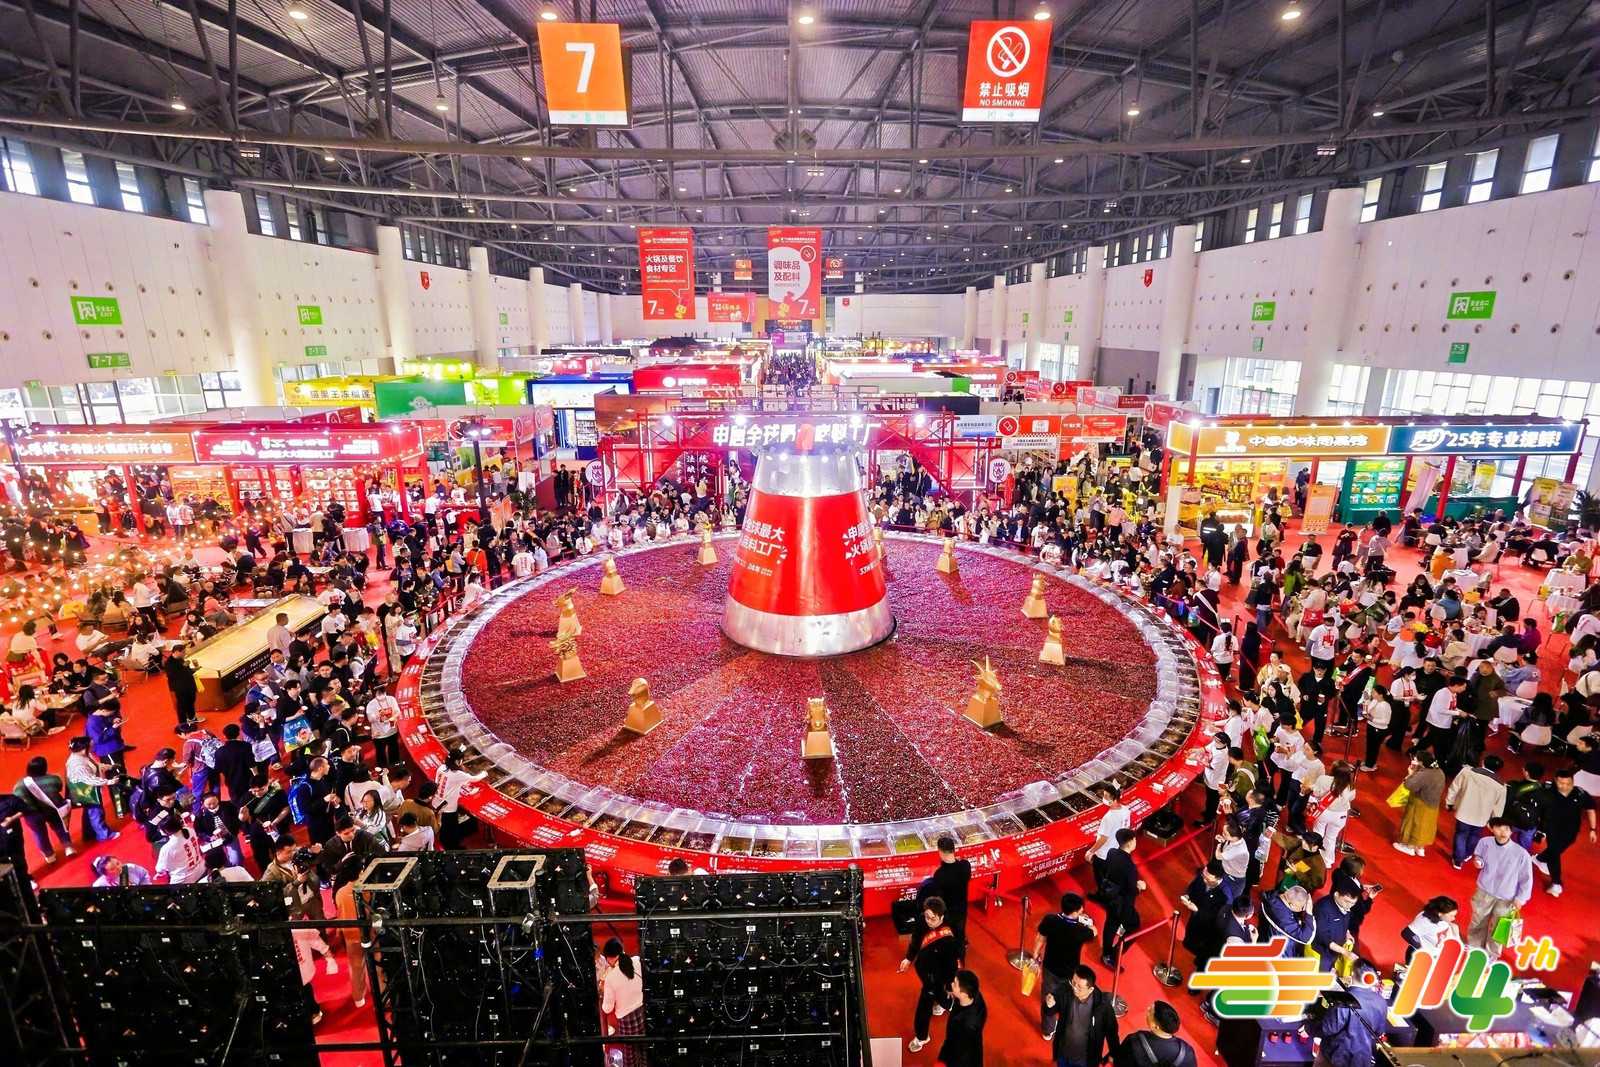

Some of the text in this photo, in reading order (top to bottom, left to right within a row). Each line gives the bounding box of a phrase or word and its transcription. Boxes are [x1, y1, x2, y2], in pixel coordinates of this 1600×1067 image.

[565, 42, 596, 93] 7
[979, 82, 1030, 98] 禁止吸烟
[991, 99, 1026, 107] SMOKING
[645, 254, 684, 263] 火锅及餐饮
[646, 264, 677, 273] 食材专区
[773, 260, 801, 270] 调味品
[773, 272, 801, 281] 及配料
[647, 300, 658, 315] 7
[798, 299, 809, 315] 7
[92, 355, 112, 367] 7-7
[741, 532, 782, 557] 底料工厂
